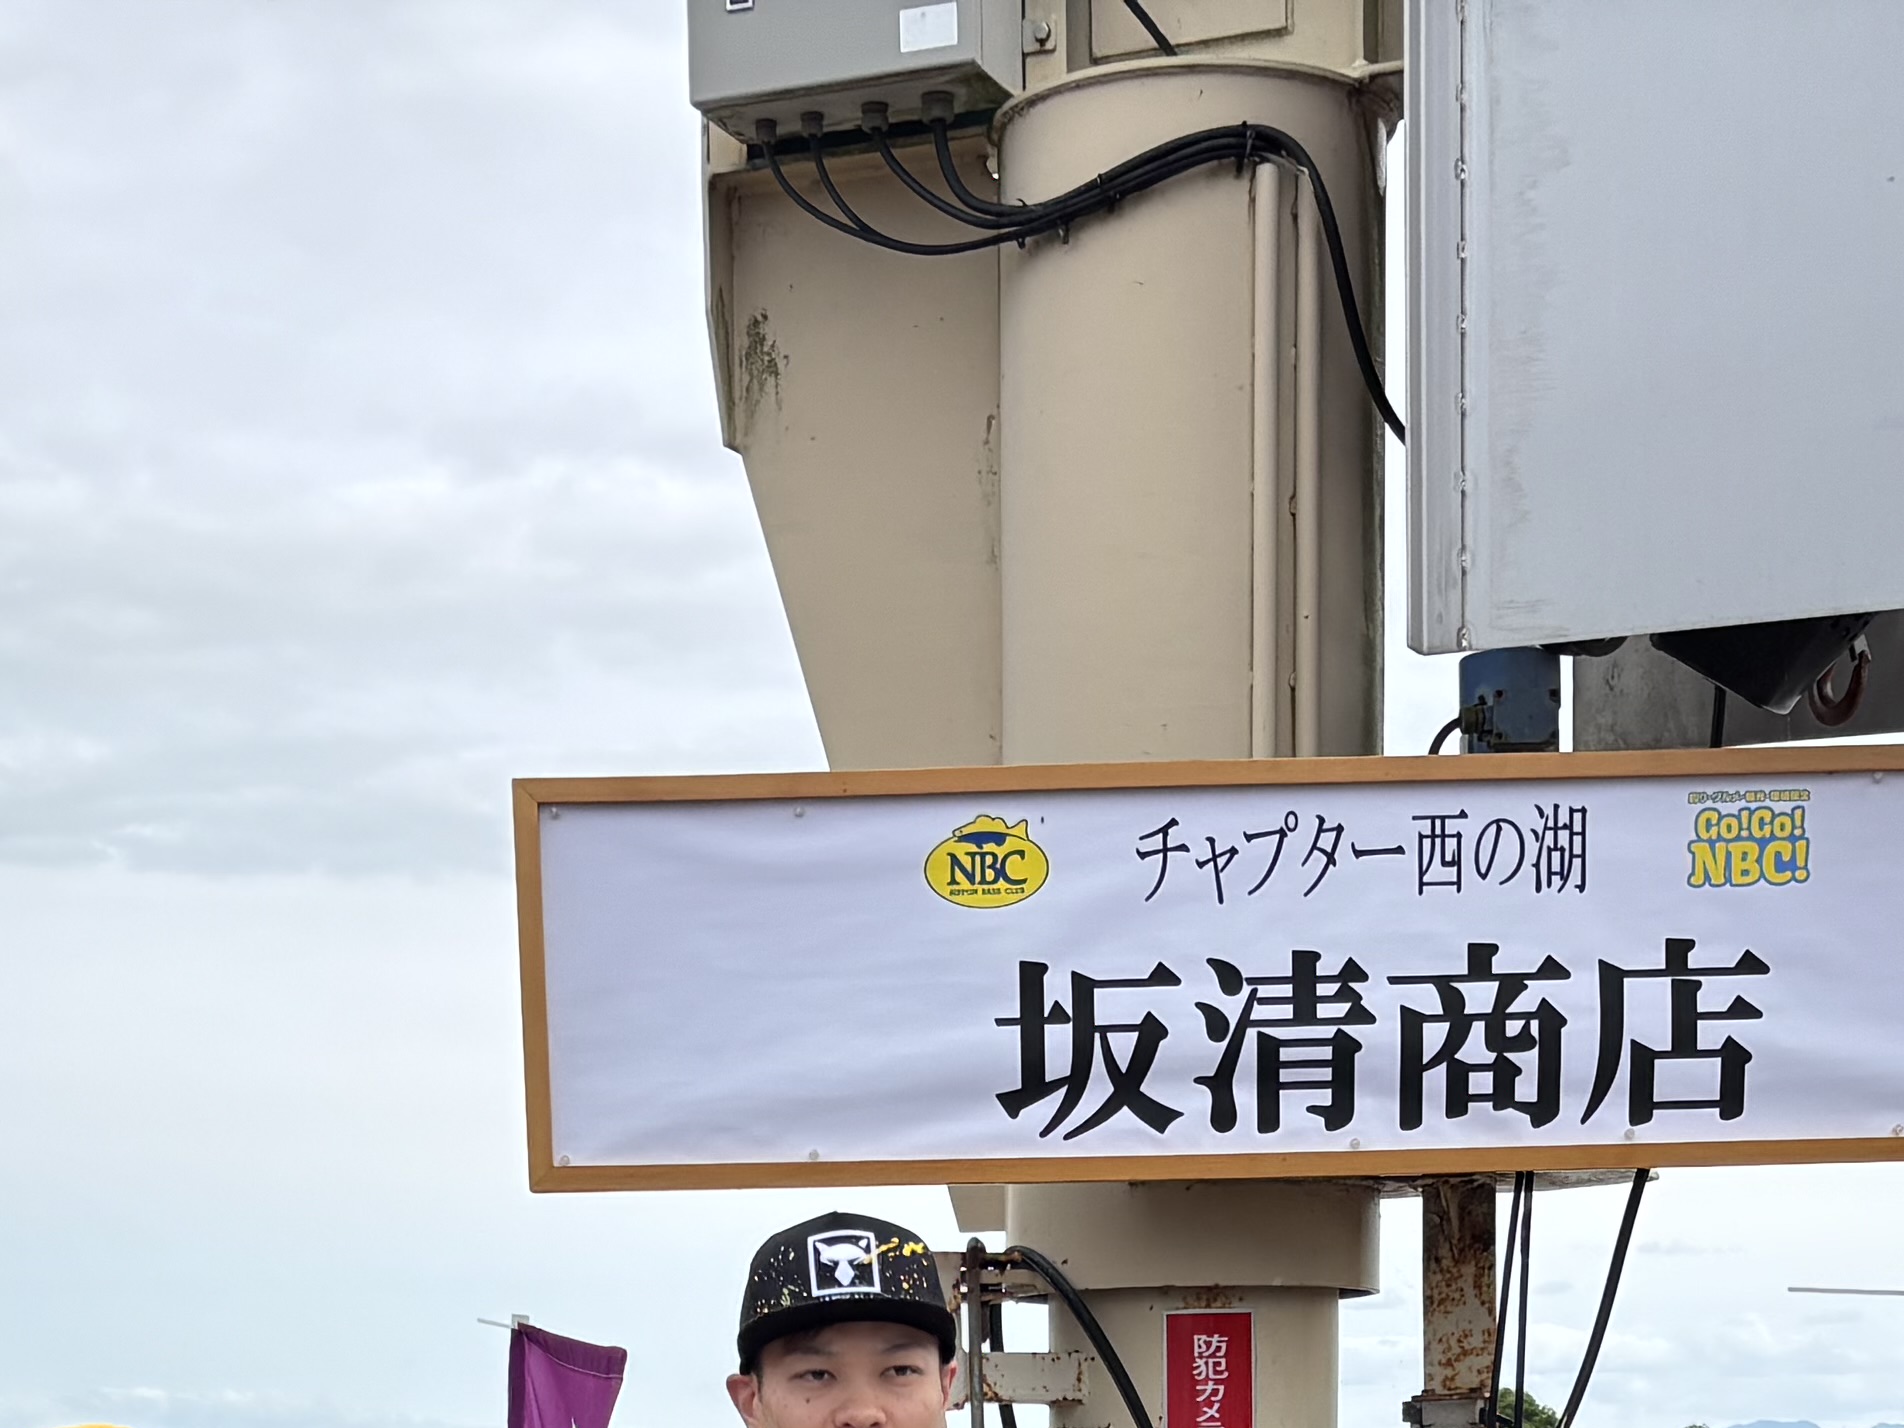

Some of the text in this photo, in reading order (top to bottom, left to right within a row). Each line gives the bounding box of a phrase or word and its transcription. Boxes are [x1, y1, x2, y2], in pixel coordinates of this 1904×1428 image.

[1696, 806, 1805, 840] Go!Go!
[946, 849, 1029, 886] NBC
[1135, 802, 1589, 906] チャプター西の湖
[1688, 838, 1809, 887] NBC!
[993, 938, 1771, 1140] 坂清商店
